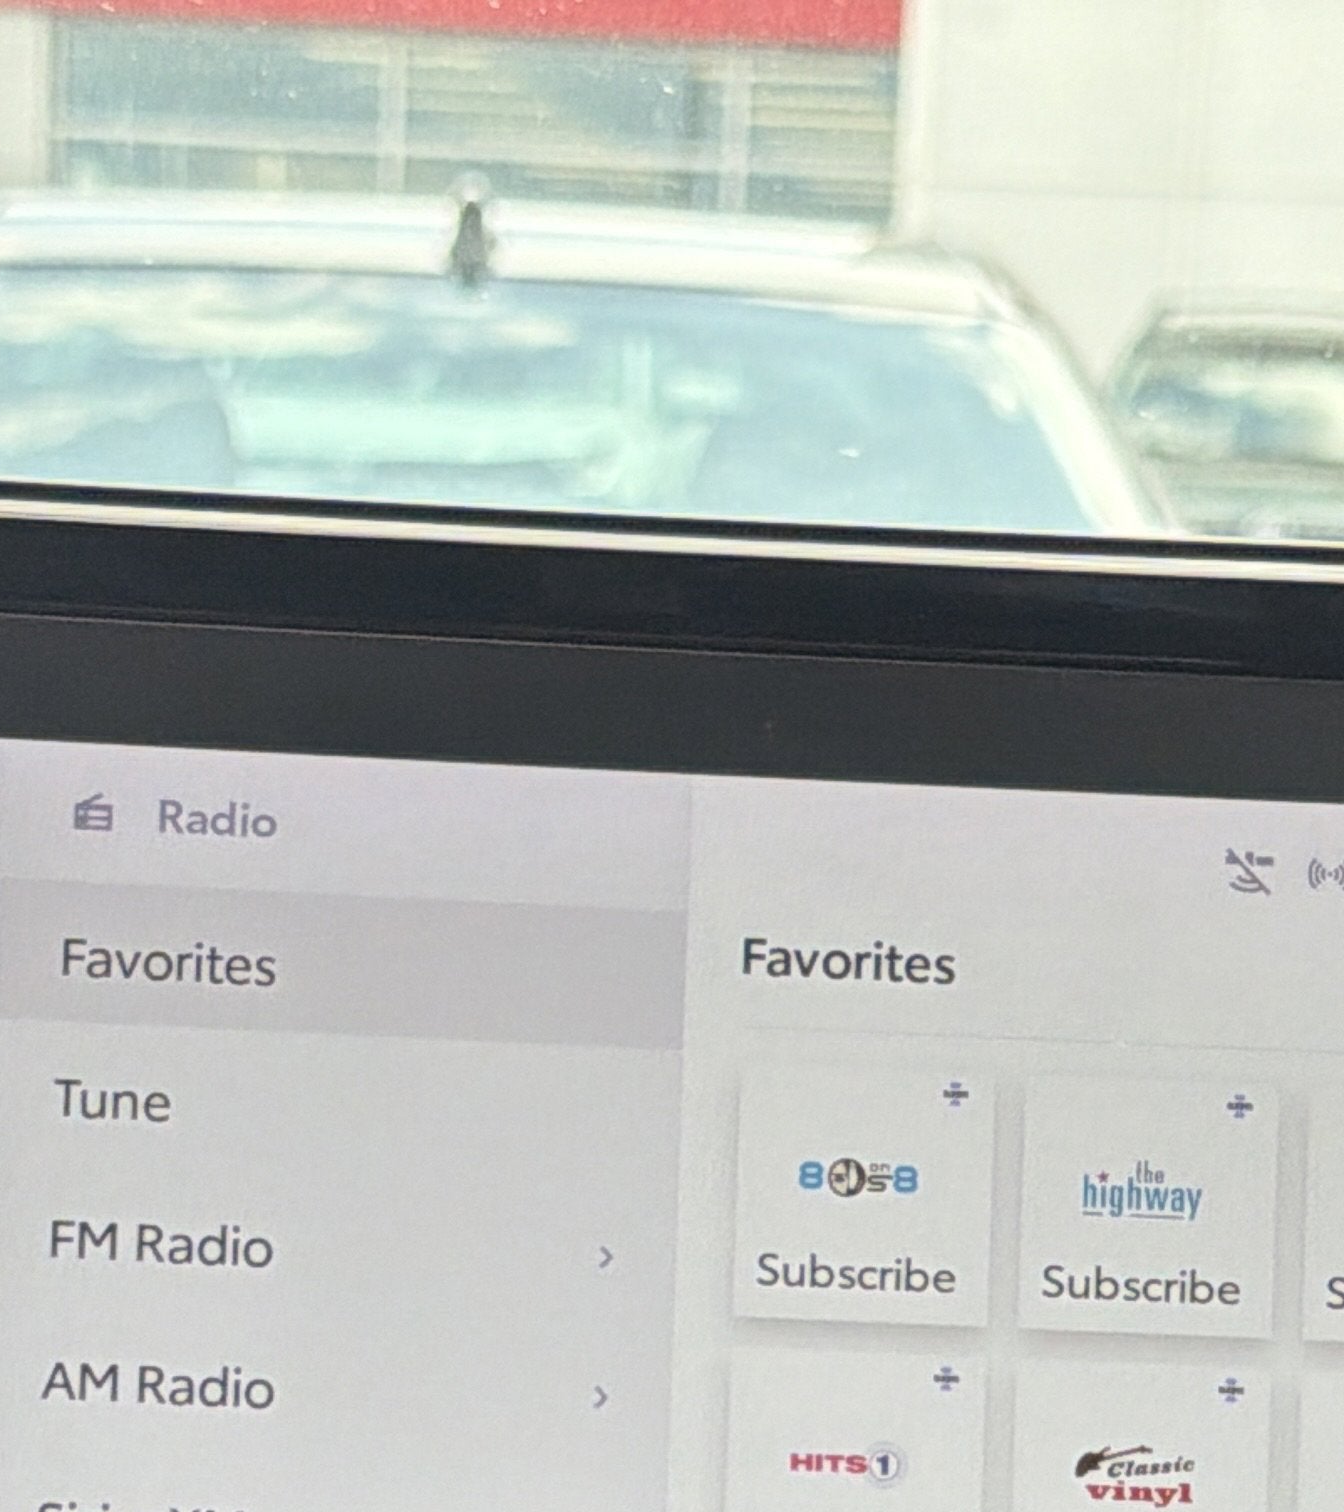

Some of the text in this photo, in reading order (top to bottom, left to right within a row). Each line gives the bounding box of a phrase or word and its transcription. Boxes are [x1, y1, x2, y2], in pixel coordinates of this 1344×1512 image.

[158, 799, 278, 838] Radio
[62, 938, 276, 987] Favorites
[742, 937, 956, 985] Favorites
[54, 1078, 171, 1123] Tune
[1135, 1160, 1164, 1183] the
[1082, 1174, 1202, 1221] highway
[50, 1219, 274, 1268] FM Radio
[756, 1252, 956, 1294] Subscribe
[1042, 1264, 1241, 1306] Subscribe
[41, 1362, 275, 1410] AM Radio
[790, 1453, 889, 1475] HITS 1
[1107, 1456, 1195, 1478] Classic
[1085, 1480, 1193, 1507] vinyl
